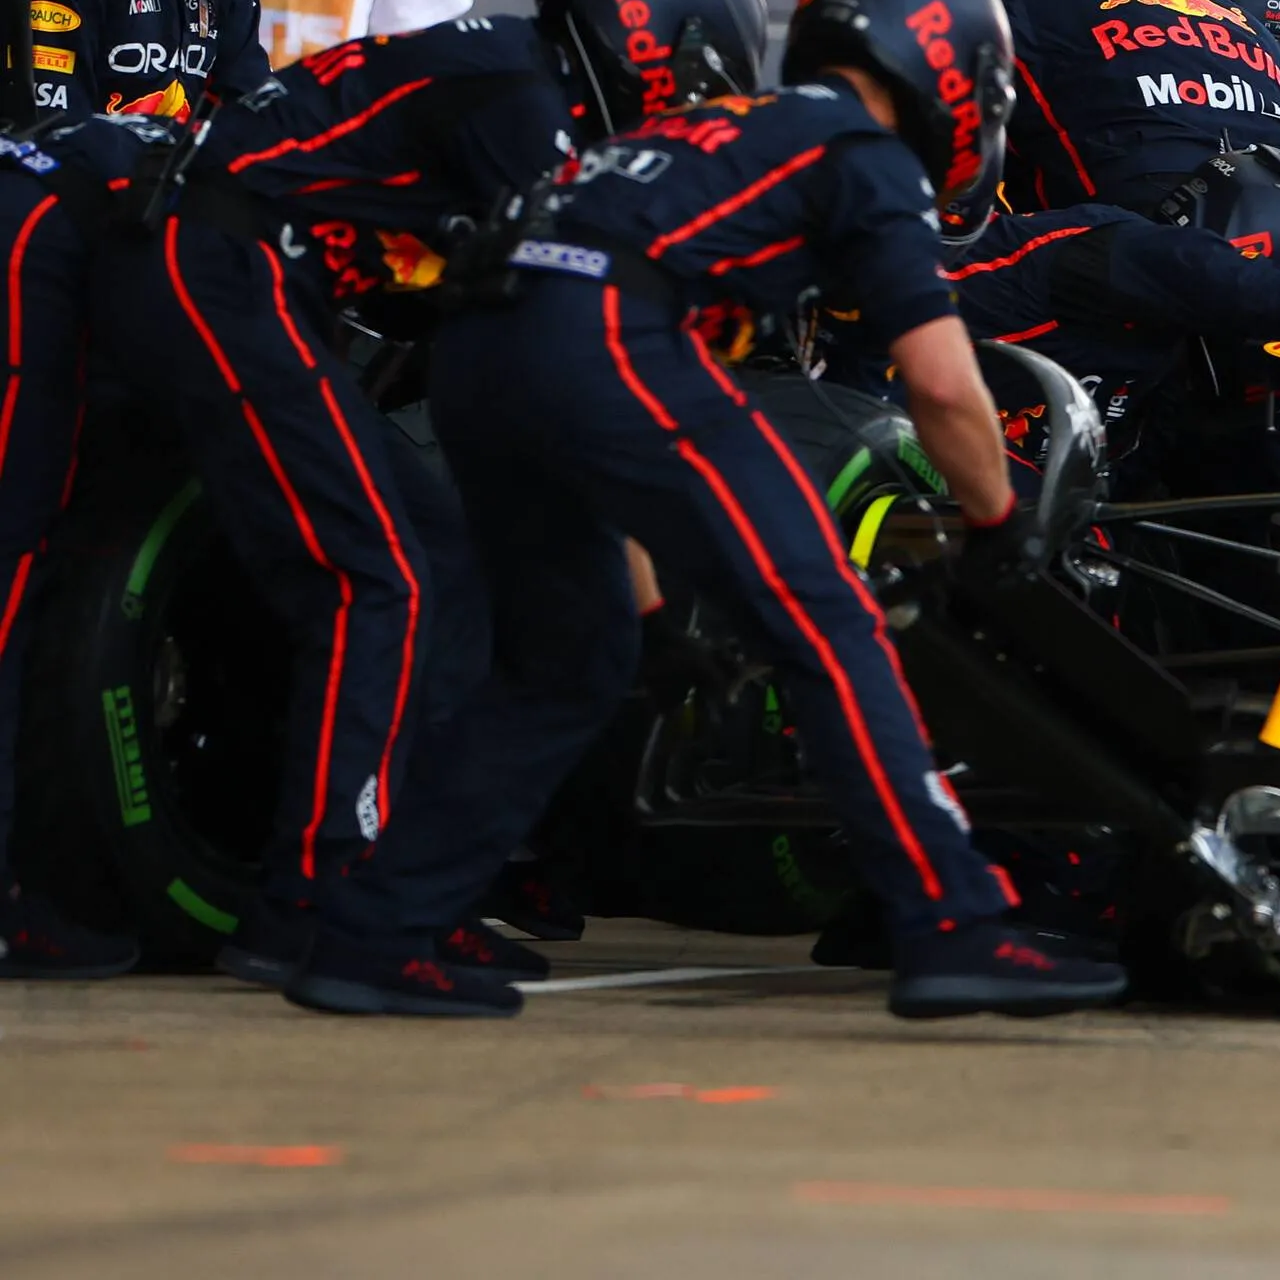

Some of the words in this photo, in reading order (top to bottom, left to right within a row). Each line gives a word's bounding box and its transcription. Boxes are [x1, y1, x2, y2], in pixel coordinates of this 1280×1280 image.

[1092, 16, 1199, 61] Red
[35, 82, 67, 110] SA
[1137, 74, 1255, 111] Mobil
